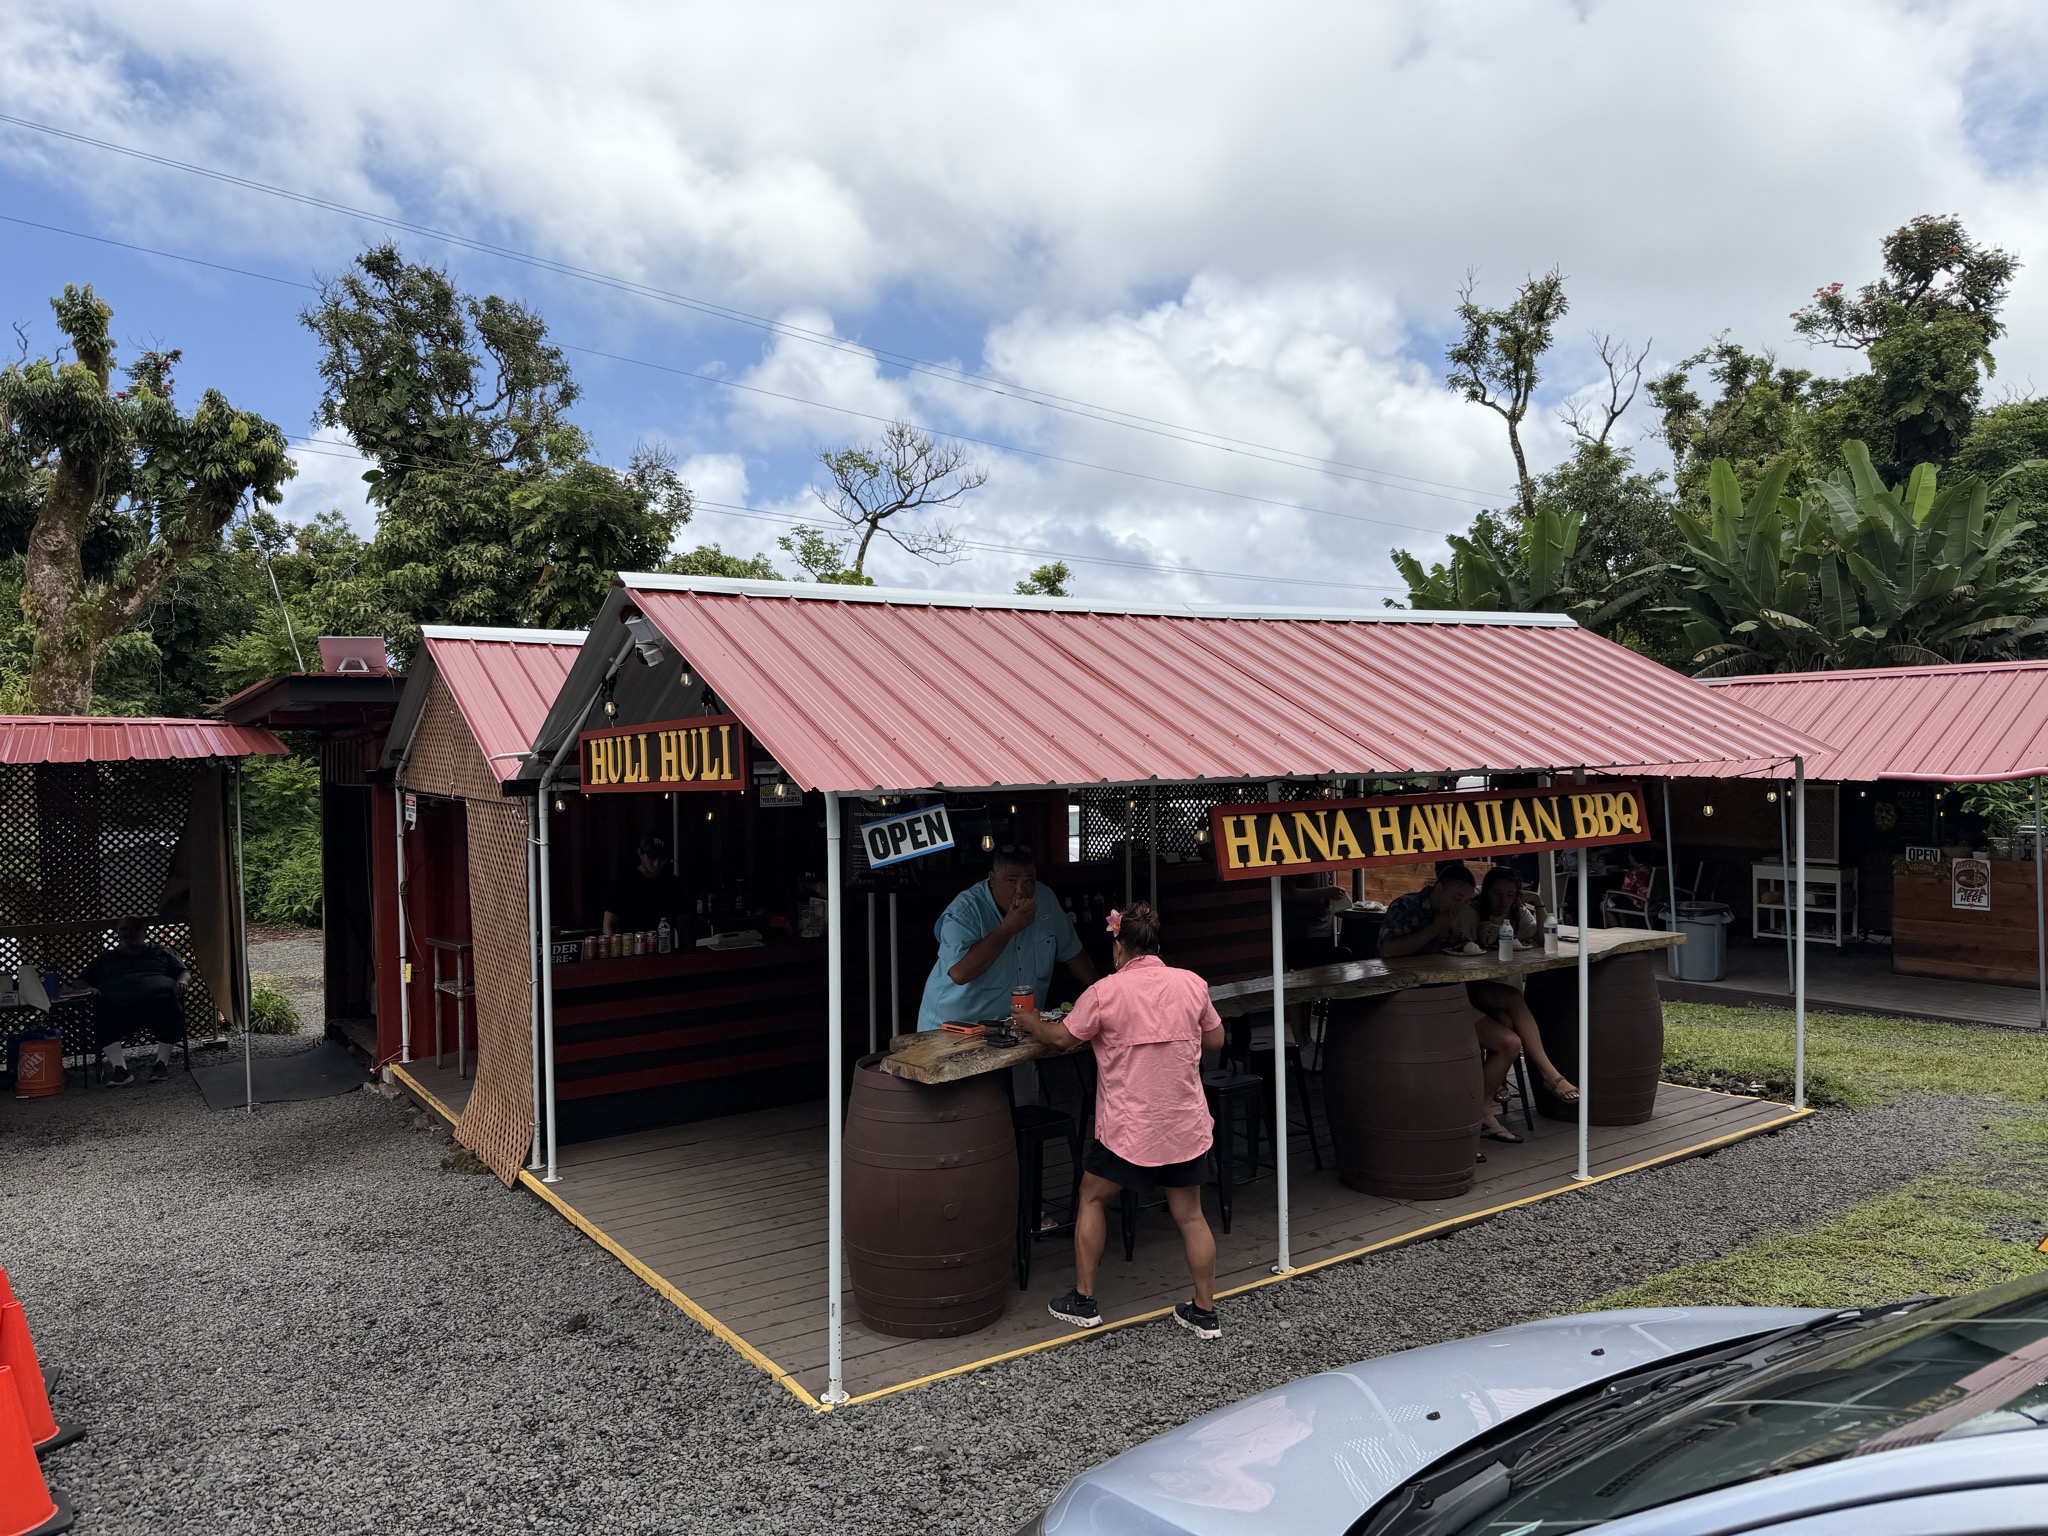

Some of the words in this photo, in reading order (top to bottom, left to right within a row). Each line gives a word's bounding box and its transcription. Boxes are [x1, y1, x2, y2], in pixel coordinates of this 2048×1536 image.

[590, 733, 650, 785] HULI
[659, 725, 734, 782] HULI
[868, 801, 948, 860] OPEN
[1221, 809, 1366, 870] HANA
[1366, 795, 1565, 857] HAWAIIAN
[1568, 791, 1642, 840] BBQ
[1908, 848, 1938, 862] OPEN
[1956, 861, 1987, 871] ORDER
[1957, 887, 1987, 896] PIZZA
[1960, 895, 1984, 903] HERE
[537, 943, 578, 956] ODER
[550, 954, 569, 964] ERE
